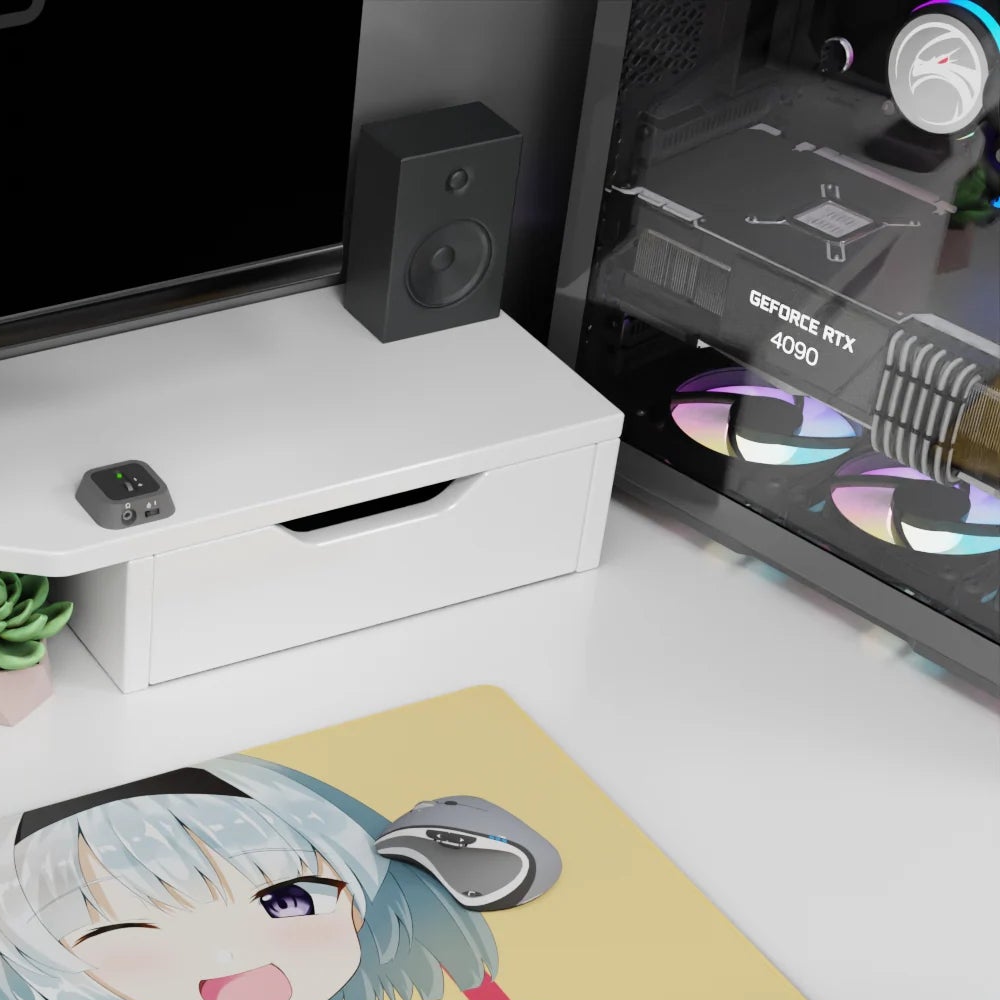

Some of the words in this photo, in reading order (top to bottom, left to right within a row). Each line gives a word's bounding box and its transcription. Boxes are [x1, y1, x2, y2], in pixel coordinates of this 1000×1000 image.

[749, 289, 820, 336] GEFORCE
[822, 325, 856, 354] RTX
[770, 331, 819, 367] 4090
